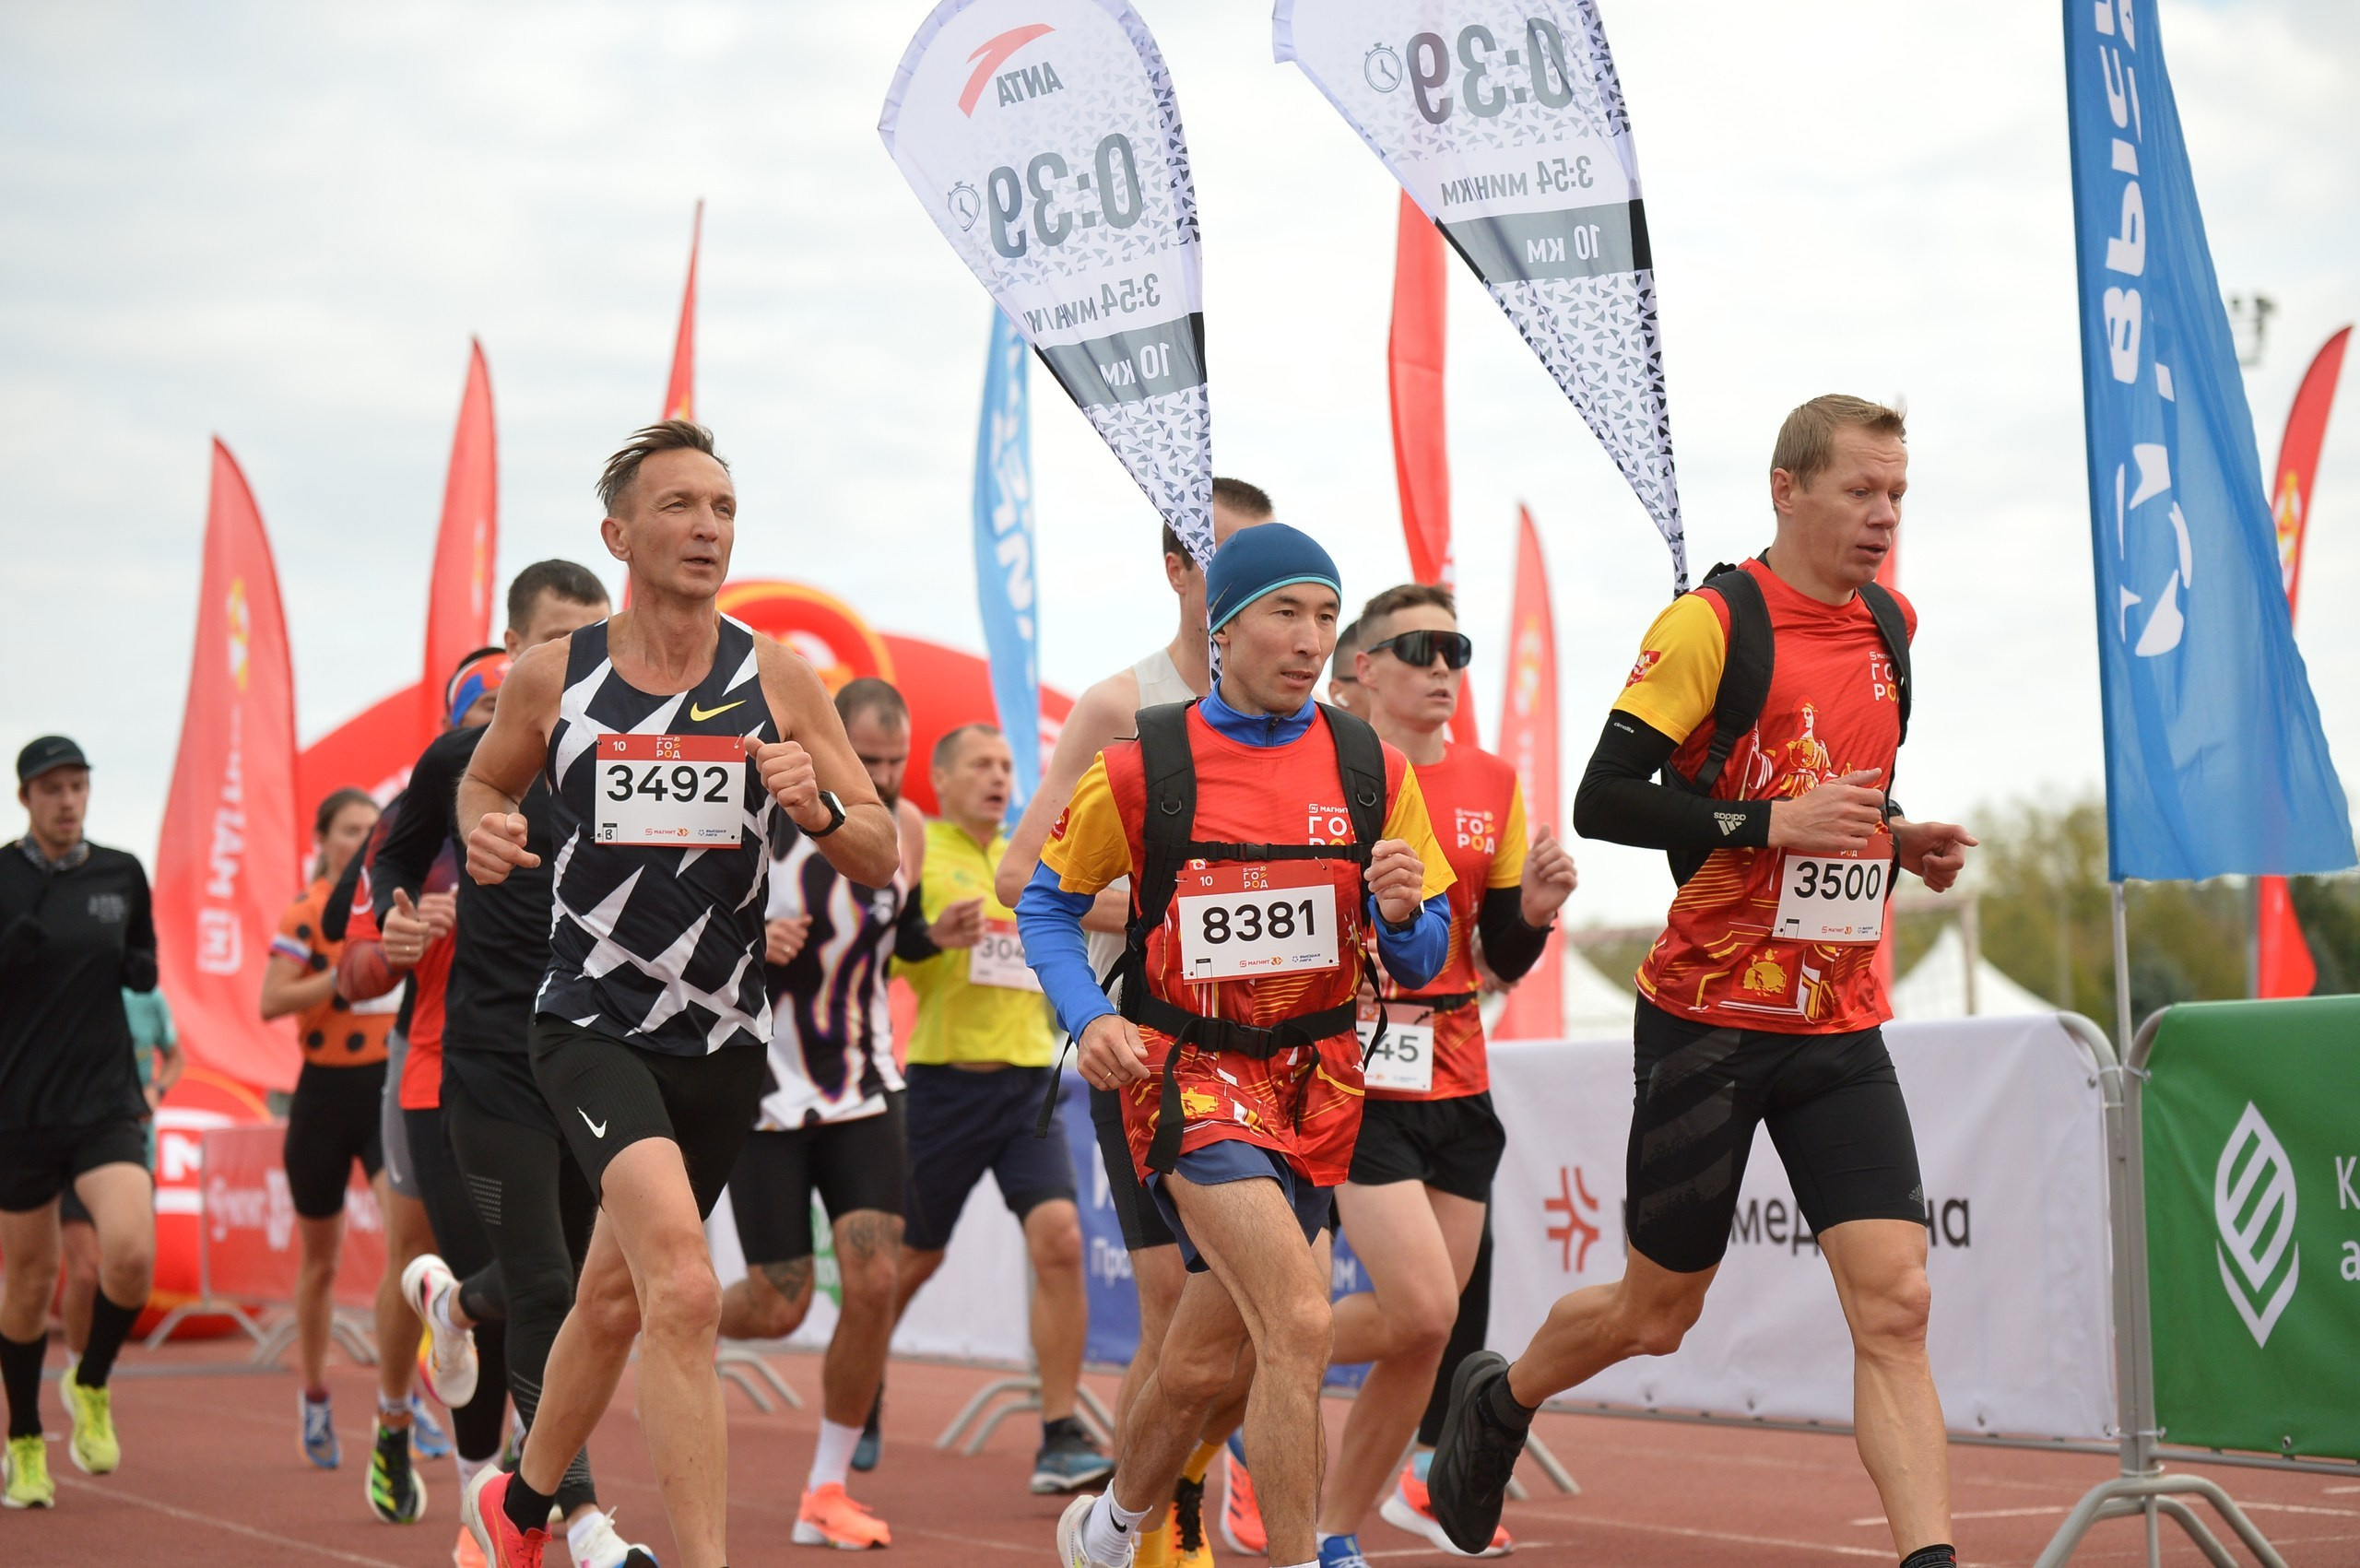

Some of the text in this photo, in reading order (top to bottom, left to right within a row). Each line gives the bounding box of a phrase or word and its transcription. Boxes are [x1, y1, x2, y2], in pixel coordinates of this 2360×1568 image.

[1873, 683, 1899, 704] РО
[612, 740, 627, 752] 10
[656, 749, 681, 760] РОД
[607, 764, 728, 803] 3492
[1713, 811, 1747, 822] adidas
[1457, 832, 1495, 855] РОД
[1199, 876, 1213, 887] 10
[1244, 879, 1268, 889] РОД
[1793, 860, 1882, 901] 3500
[1202, 899, 1315, 945] 8381
